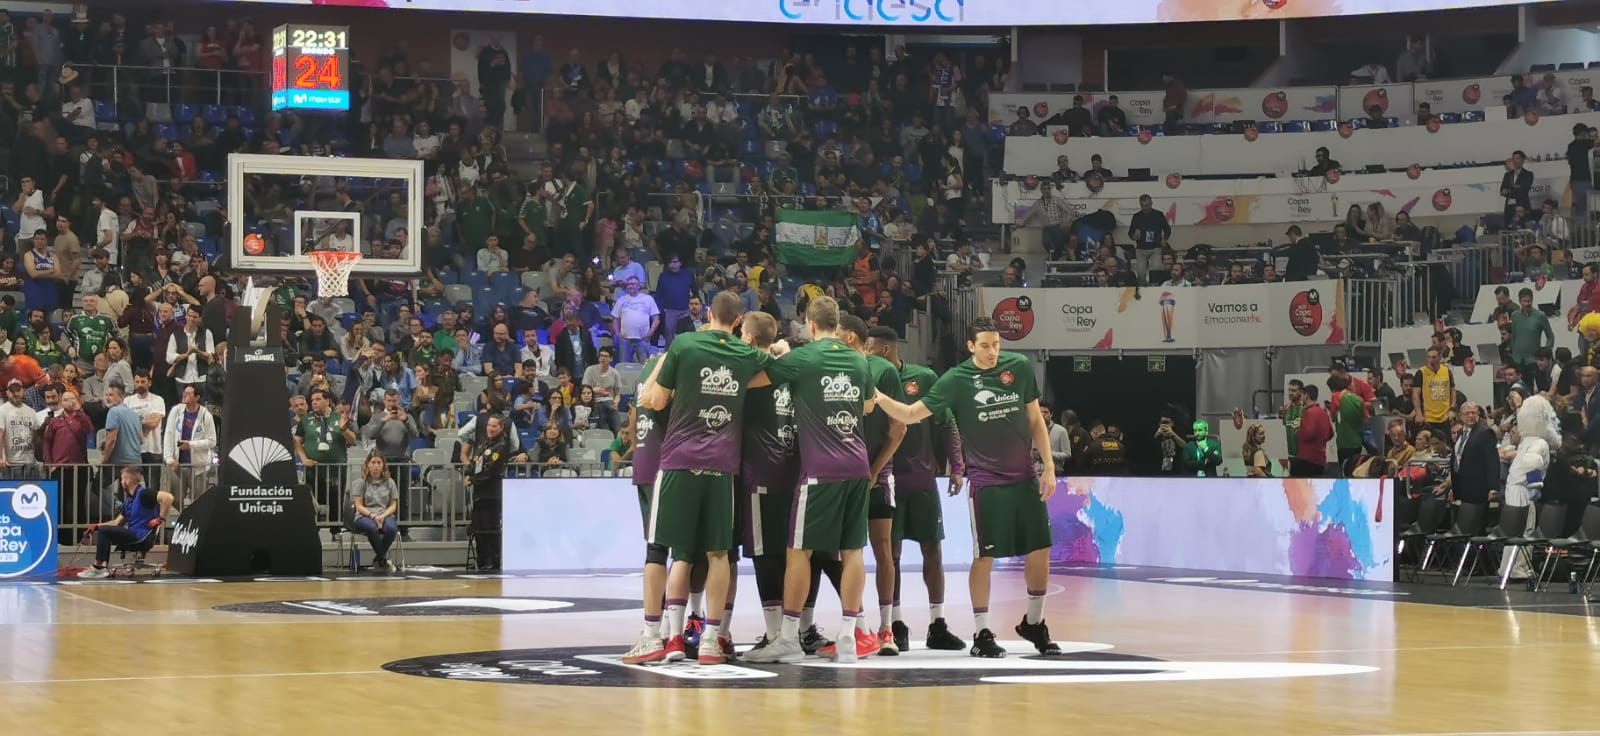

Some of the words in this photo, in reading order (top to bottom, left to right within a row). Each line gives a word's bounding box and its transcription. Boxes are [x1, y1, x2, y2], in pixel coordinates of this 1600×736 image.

[292, 29, 346, 48] 22:31
[301, 47, 335, 55] MONDO
[294, 55, 342, 90] 24
[309, 95, 342, 104] movistar
[1061, 304, 1093, 316] Copa
[1208, 302, 1248, 313] Vamos
[1249, 303, 1259, 312] a
[999, 314, 1021, 324] Copa
[1076, 317, 1097, 328] Rey
[699, 366, 739, 392] 2020
[820, 375, 861, 398] 2020
[698, 408, 717, 419] Hard
[230, 484, 293, 497] Fundación
[239, 500, 284, 515] Unicaja
[0, 538, 28, 554] Rey
